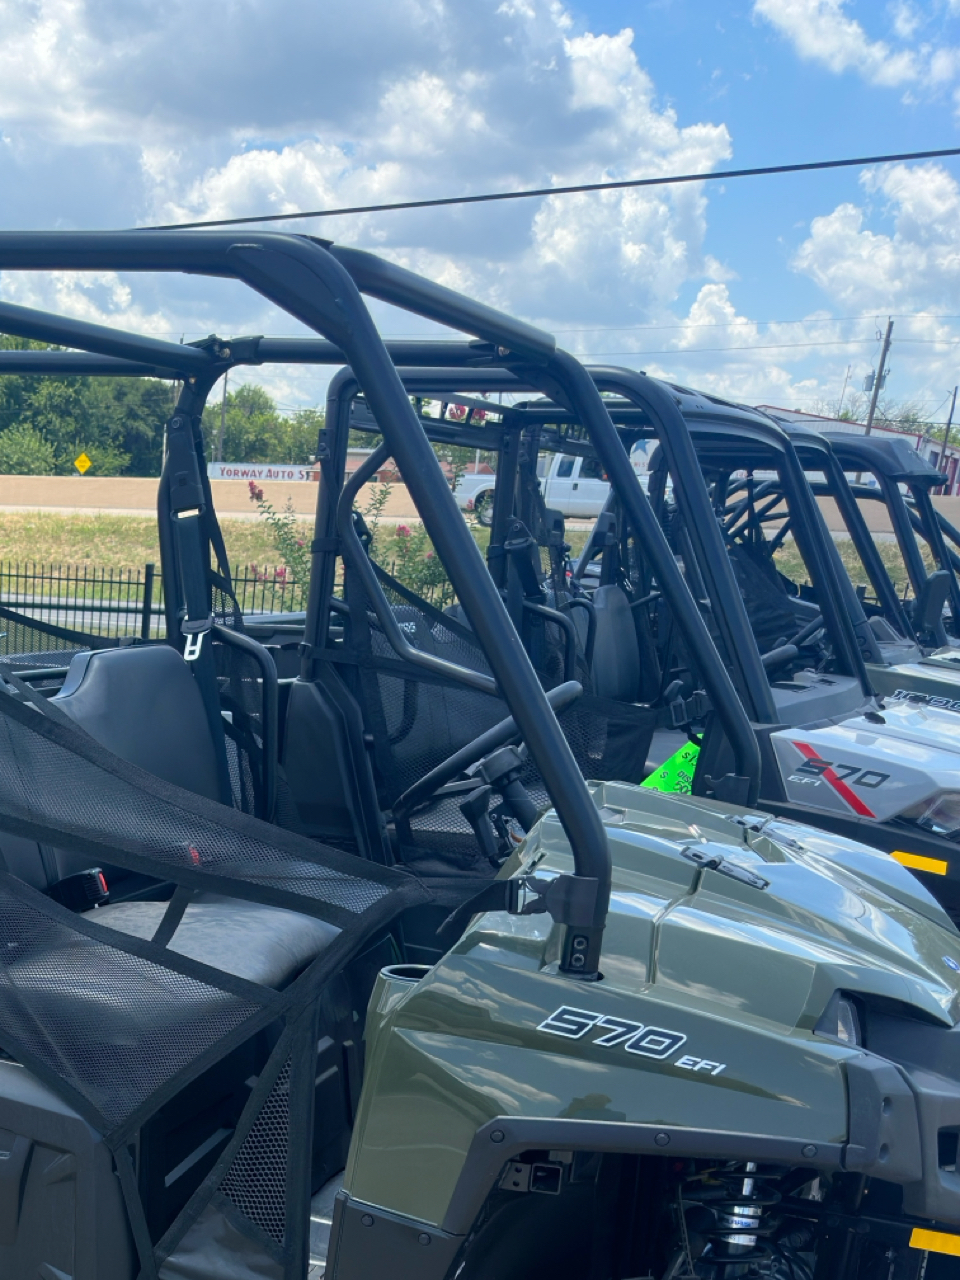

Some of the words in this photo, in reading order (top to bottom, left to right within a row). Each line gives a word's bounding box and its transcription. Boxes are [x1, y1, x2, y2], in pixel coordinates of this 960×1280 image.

[787, 775, 823, 787] EFI
[795, 757, 891, 789] 570
[536, 1005, 687, 1060] 570
[674, 1054, 727, 1076] EFI
